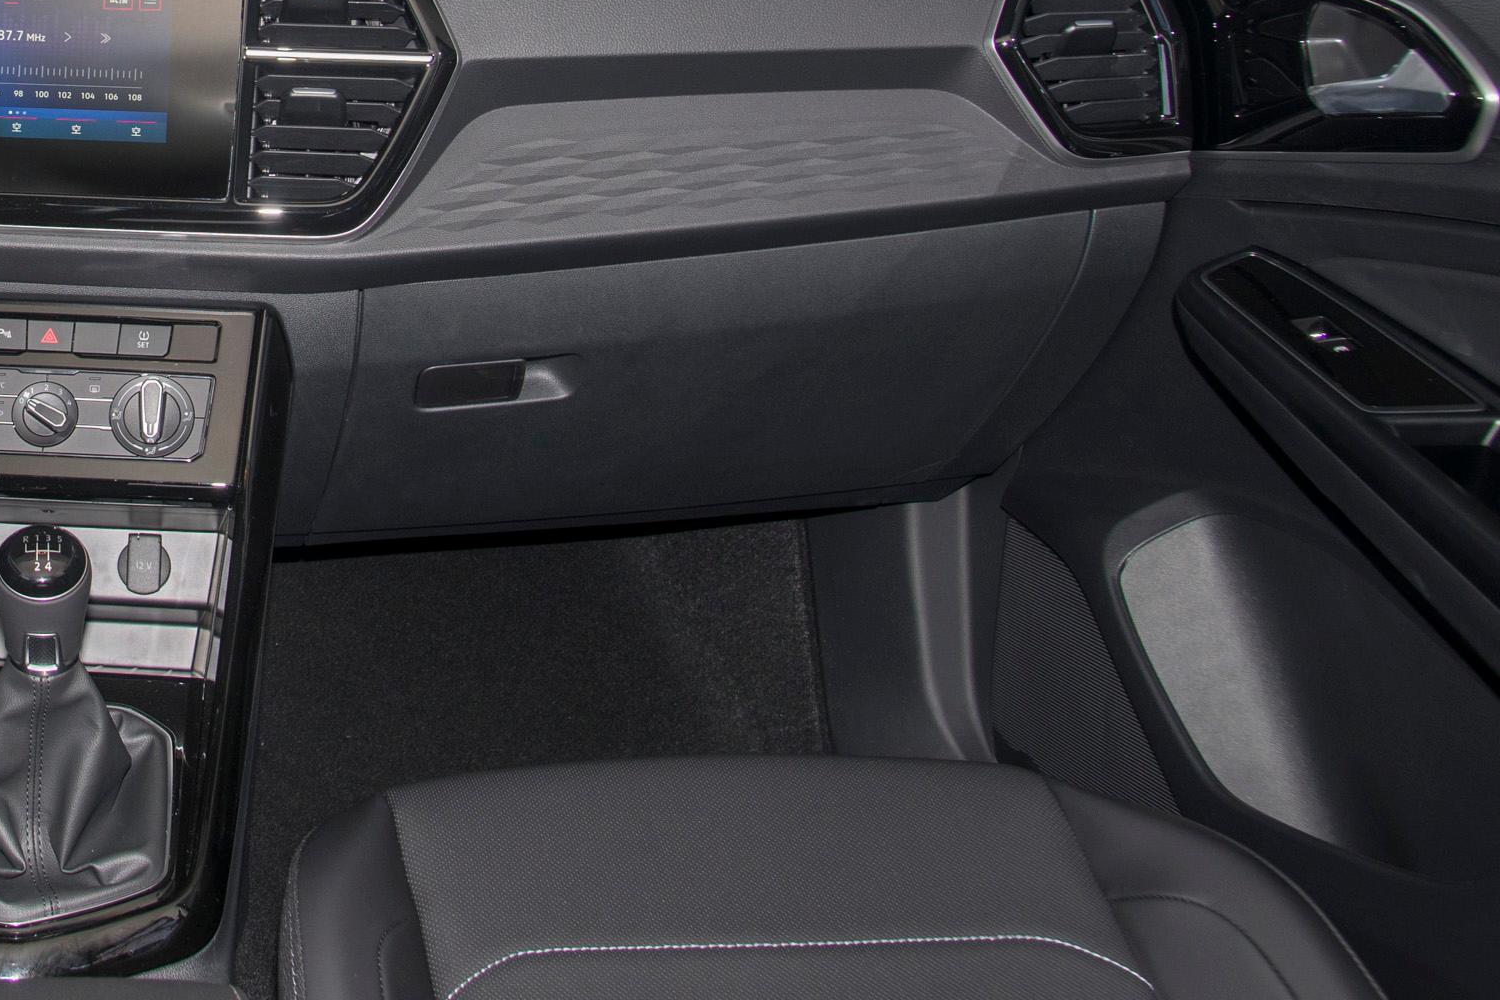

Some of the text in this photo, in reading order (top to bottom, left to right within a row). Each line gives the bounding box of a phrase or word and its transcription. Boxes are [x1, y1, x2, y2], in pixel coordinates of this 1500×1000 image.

[26, 33, 46, 42] MHz
[13, 89, 24, 98] 98
[34, 90, 49, 98] 100
[57, 91, 72, 99] 102
[80, 91, 95, 100] 104
[104, 92, 119, 101] 106
[127, 93, 142, 101] 108
[57, 535, 62, 543] 5
[34, 562, 52, 571] 2 4
[136, 561, 153, 570] 12 V
